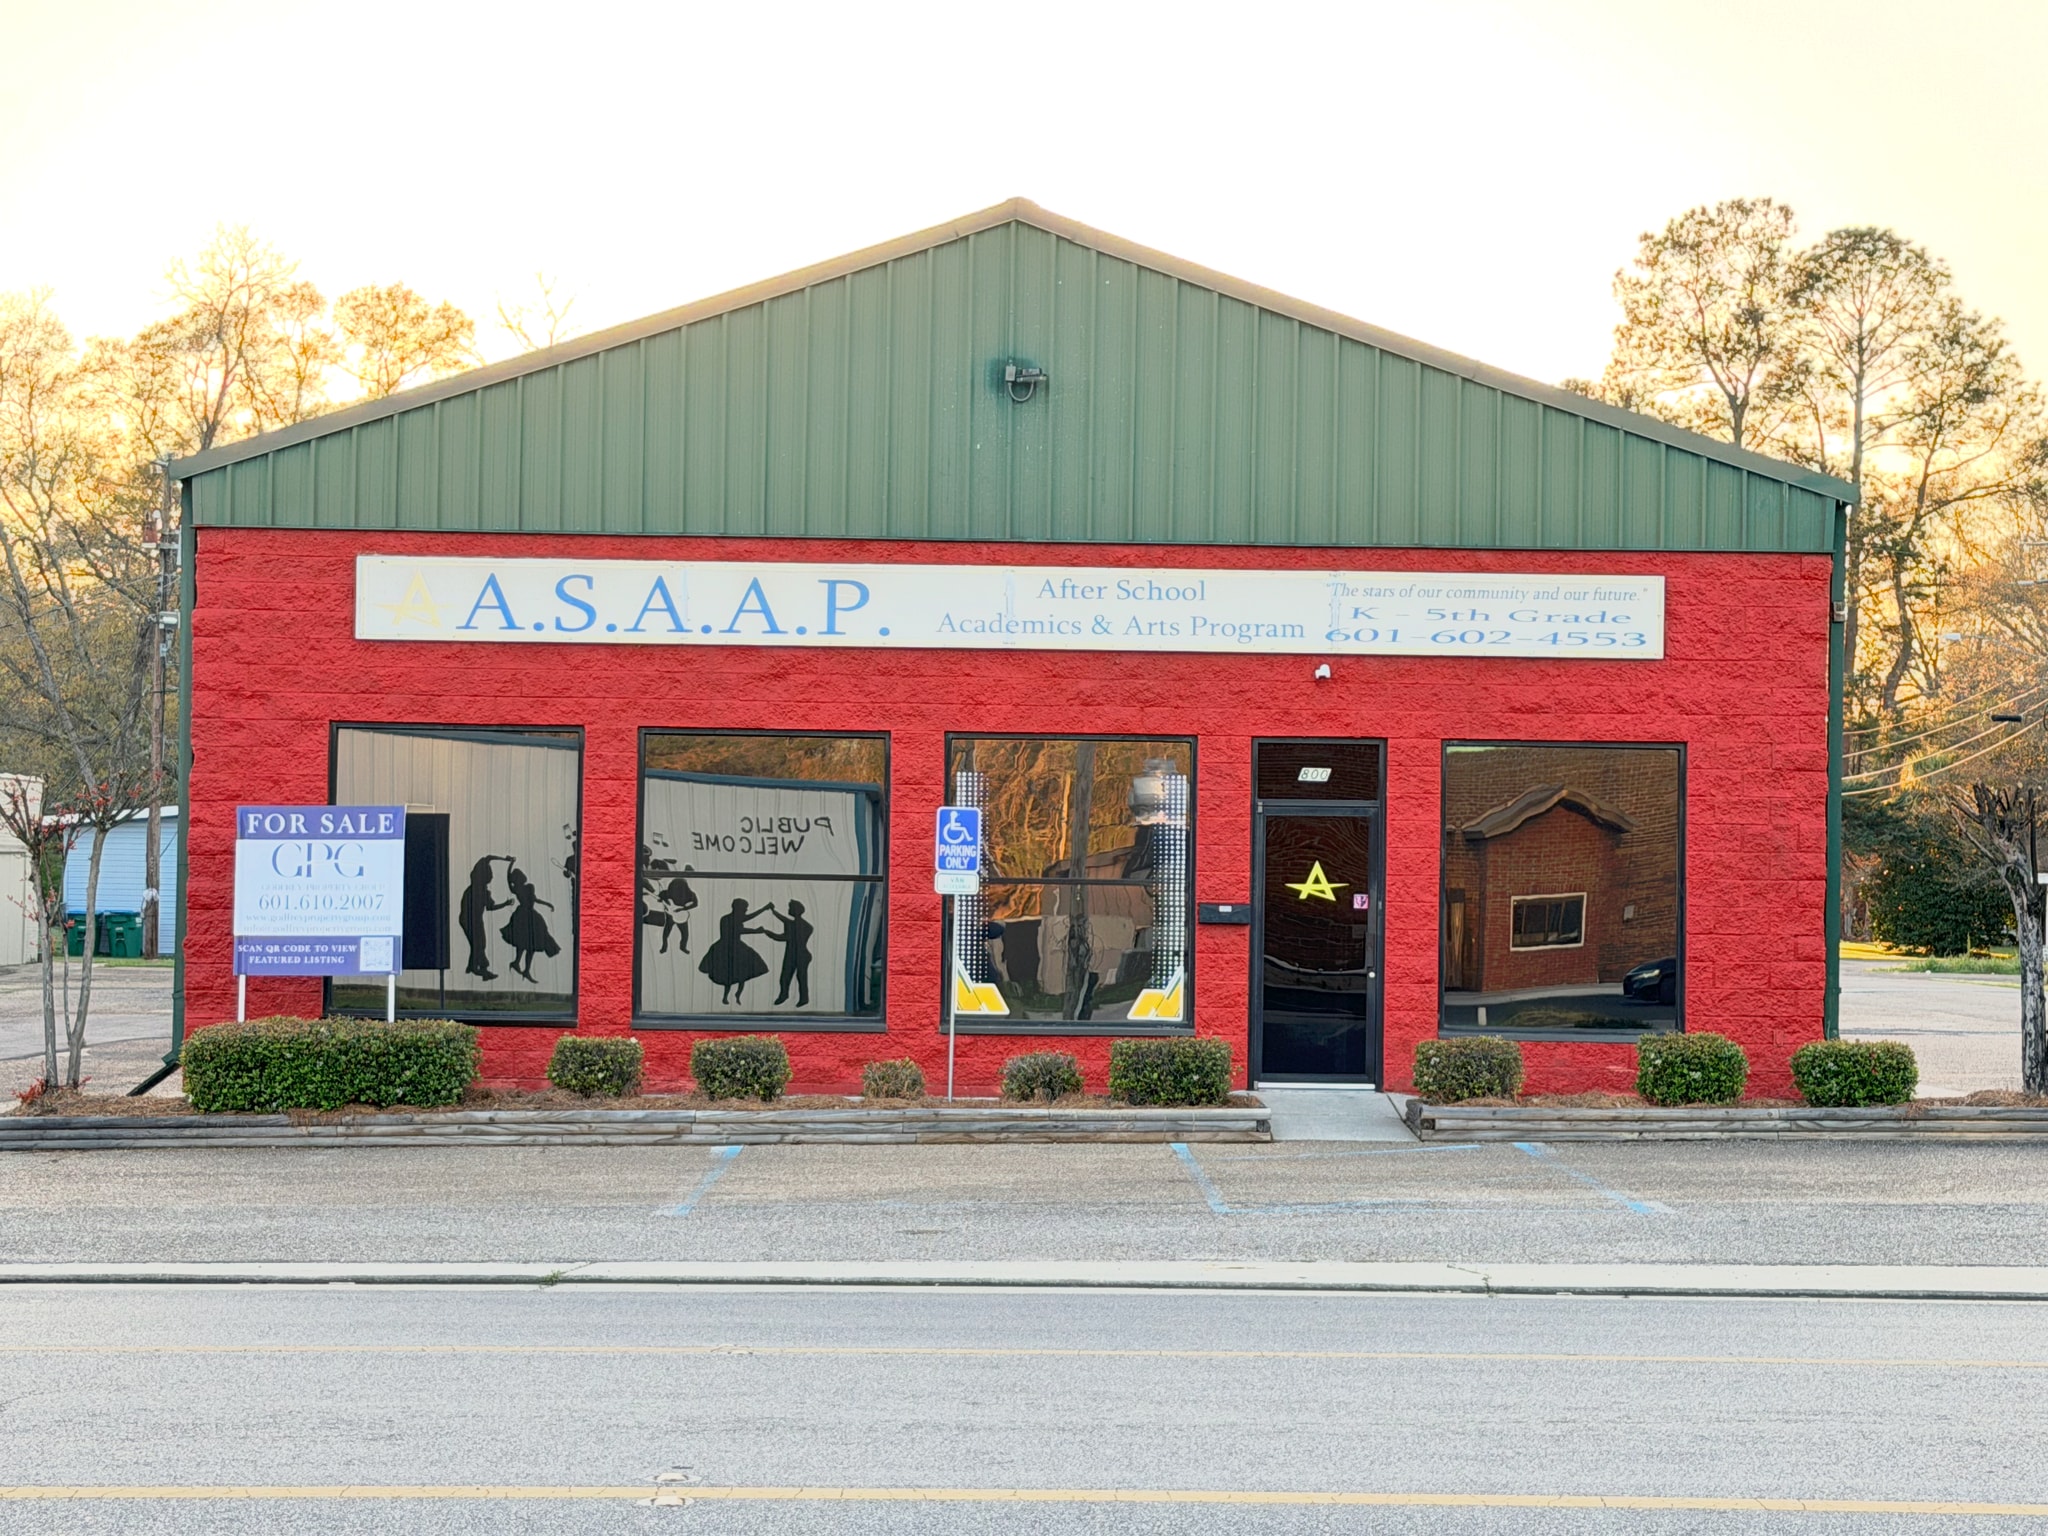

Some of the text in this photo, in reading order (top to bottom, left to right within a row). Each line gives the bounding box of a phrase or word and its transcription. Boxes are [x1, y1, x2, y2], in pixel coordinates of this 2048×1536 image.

[1036, 578, 1206, 601] After School
[1362, 585, 1397, 599] stars
[1399, 583, 1416, 599] of
[1417, 588, 1443, 600] our
[1445, 585, 1529, 604] community
[1532, 586, 1559, 601] and
[1563, 589, 1591, 601] our
[456, 572, 891, 637] A.S.A.A.P.
[1350, 606, 1381, 620] K
[1426, 608, 1490, 623] 5th
[1508, 608, 1632, 624] Grade
[936, 612, 1306, 644] Academics & Arts Program
[1325, 627, 1648, 648] 601-602-4553
[1301, 768, 1328, 780] 800
[247, 812, 395, 834] FOR SALE
[940, 844, 976, 857] PARKING
[945, 857, 970, 869] ONLY
[258, 894, 385, 911] 601.610.2007
[238, 944, 358, 953] SCAN QR CODE TO VIEW
[249, 955, 345, 964] FEATURED LISTING
